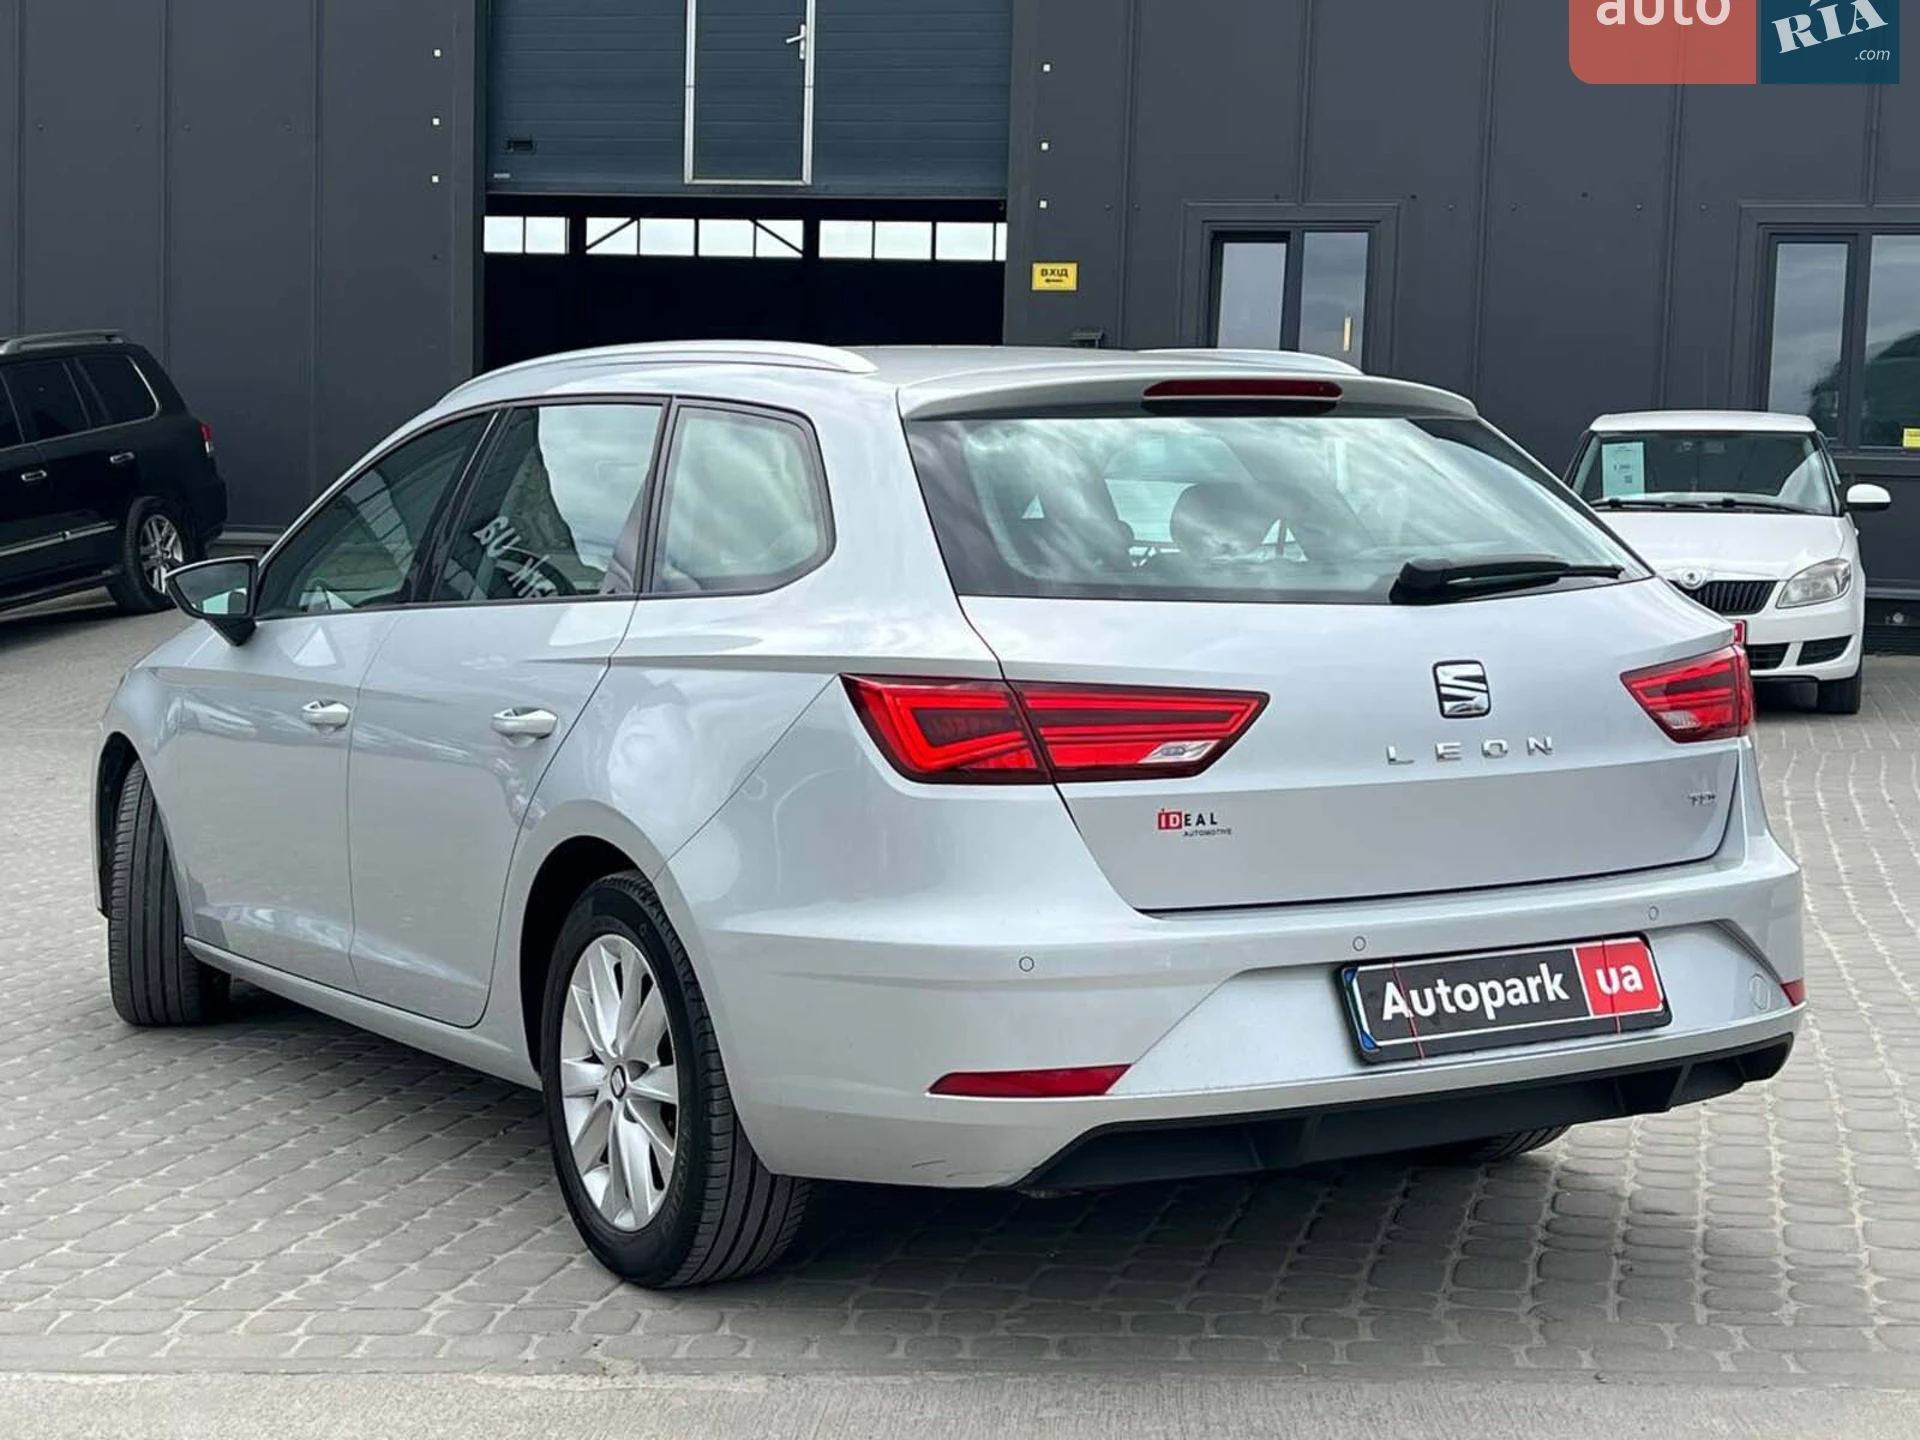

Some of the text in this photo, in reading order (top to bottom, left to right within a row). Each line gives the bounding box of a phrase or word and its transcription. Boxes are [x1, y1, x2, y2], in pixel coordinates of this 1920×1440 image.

[1386, 736, 1554, 766] LEON
[1382, 963, 1644, 1021] Autopark ua
